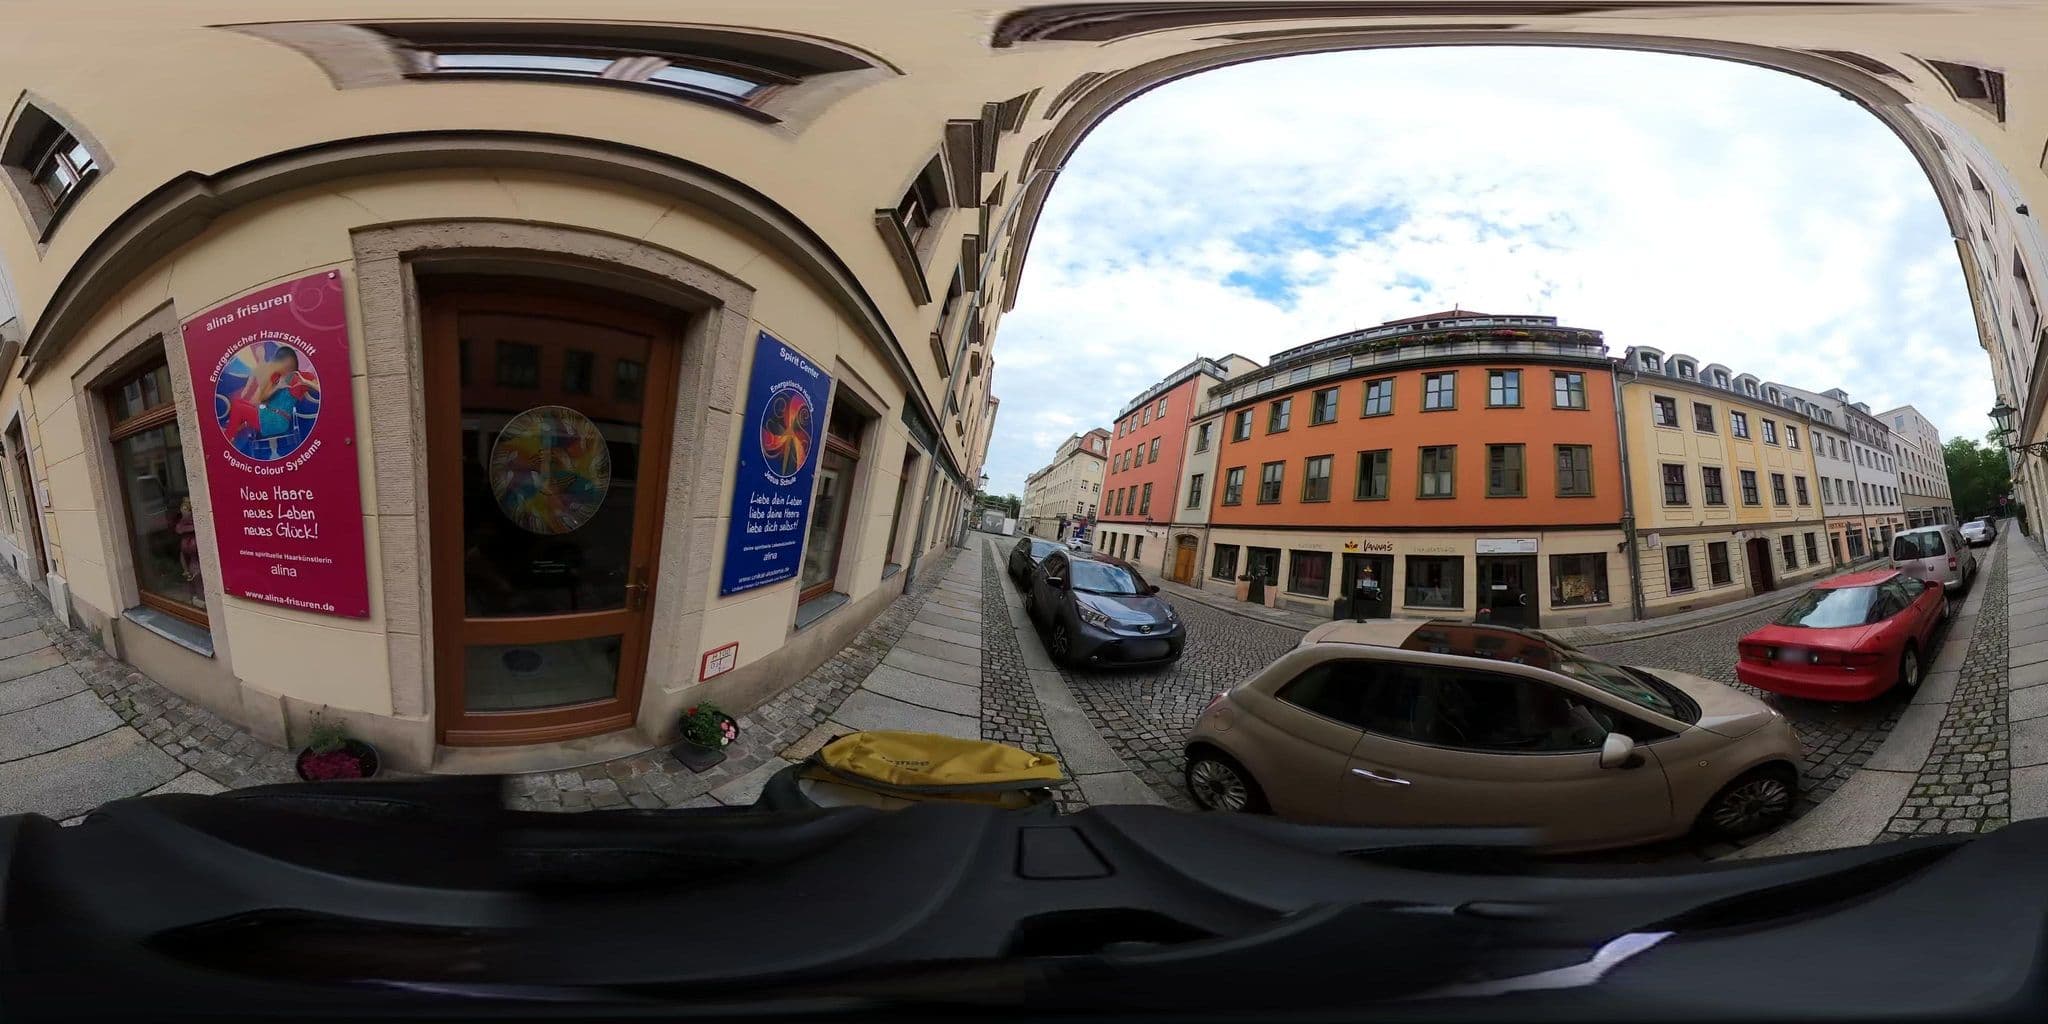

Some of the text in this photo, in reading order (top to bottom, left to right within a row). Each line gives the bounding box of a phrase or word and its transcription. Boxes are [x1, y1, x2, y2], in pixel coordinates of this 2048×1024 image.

[206, 293, 293, 331] alina frisuren
[209, 330, 317, 383] Energetischer Haarschnitt
[780, 347, 819, 379] Spirit Center
[223, 439, 321, 475] Organic Colour Systems
[240, 486, 314, 500] Neue Haare
[750, 492, 802, 506] Liebe dein Leben
[243, 504, 315, 520] neues Leben
[749, 506, 765, 519] liebe
[767, 506, 782, 519] deine
[244, 522, 318, 539] neues Glück!
[747, 520, 799, 534] liebe dich selbst!
[270, 563, 297, 577] alina
[244, 590, 335, 612] www.alina-frisuren.de
